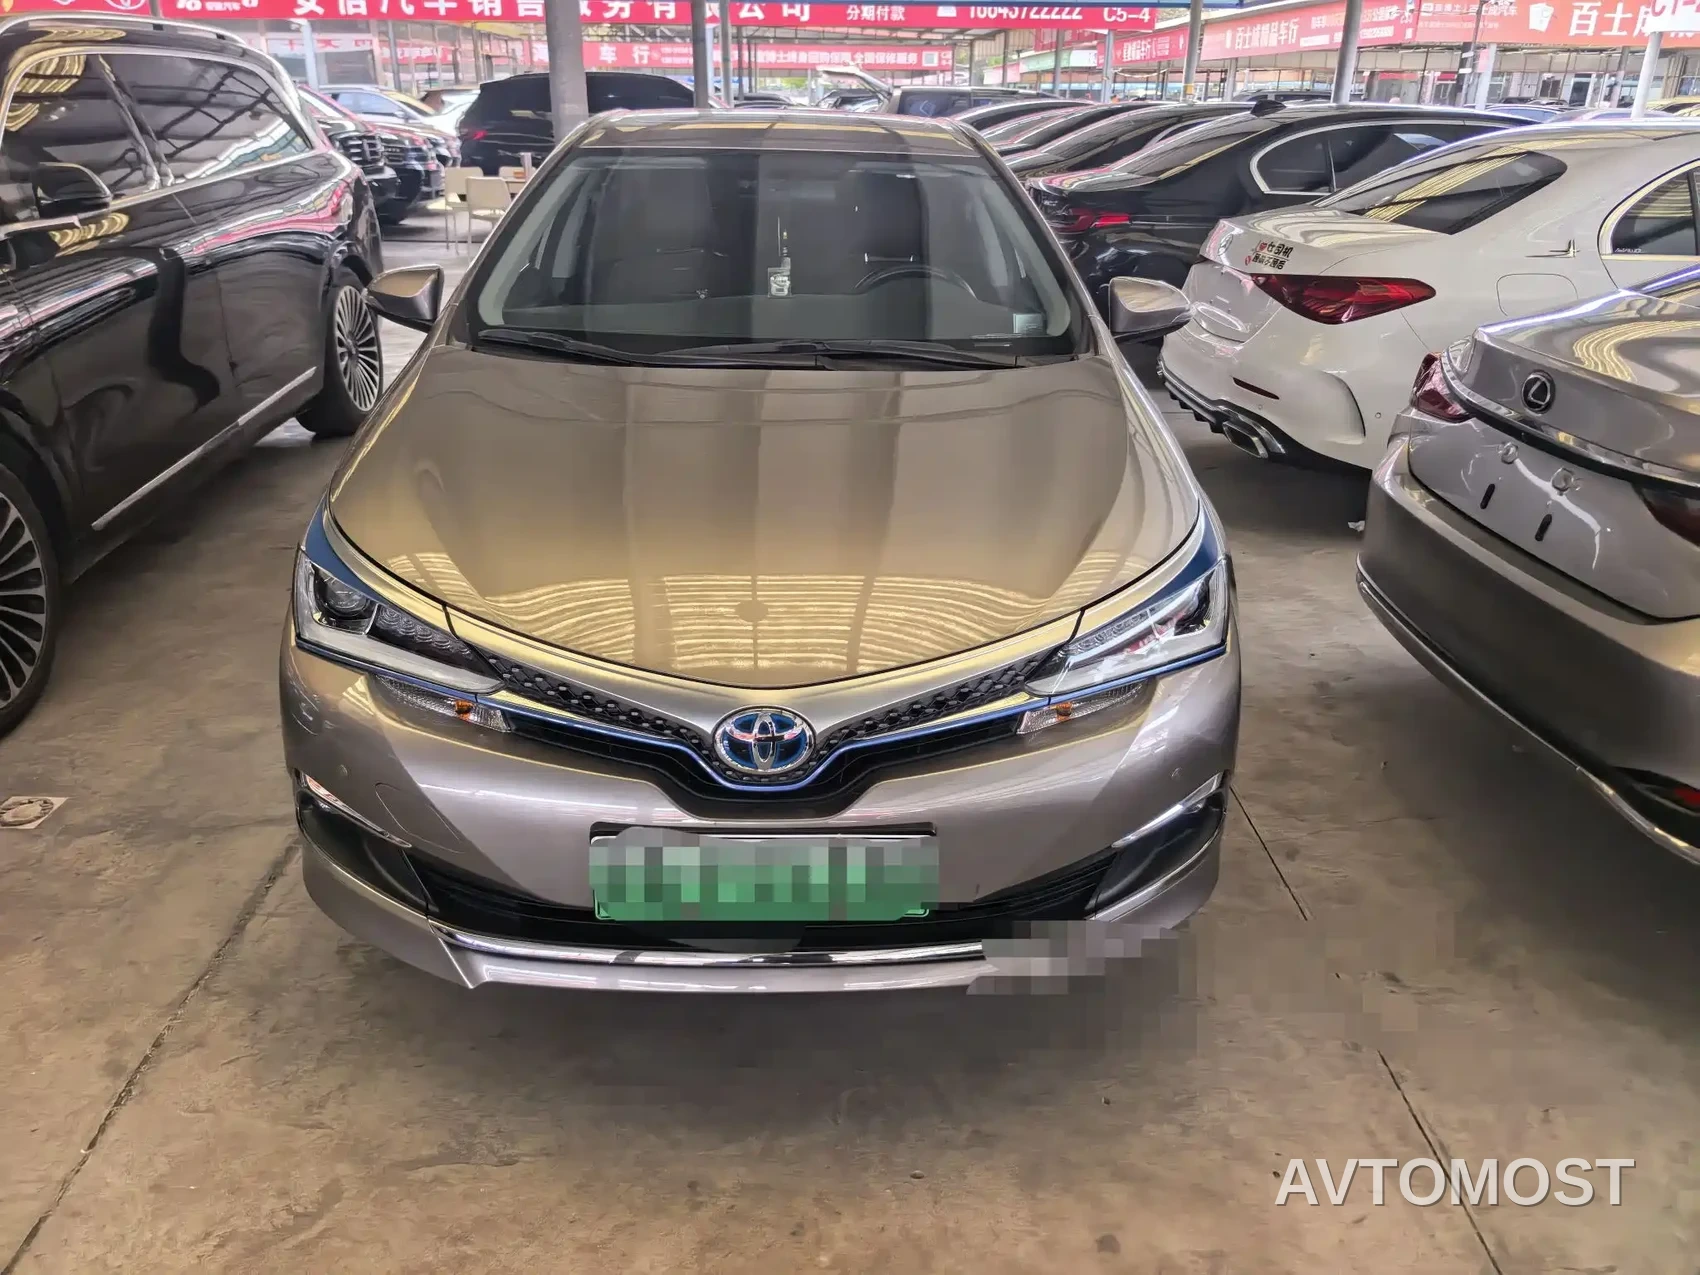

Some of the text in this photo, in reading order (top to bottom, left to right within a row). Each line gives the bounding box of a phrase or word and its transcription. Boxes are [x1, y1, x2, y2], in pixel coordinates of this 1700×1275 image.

[846, 4, 906, 21] 分期付款
[1102, 6, 1150, 23] C5-4
